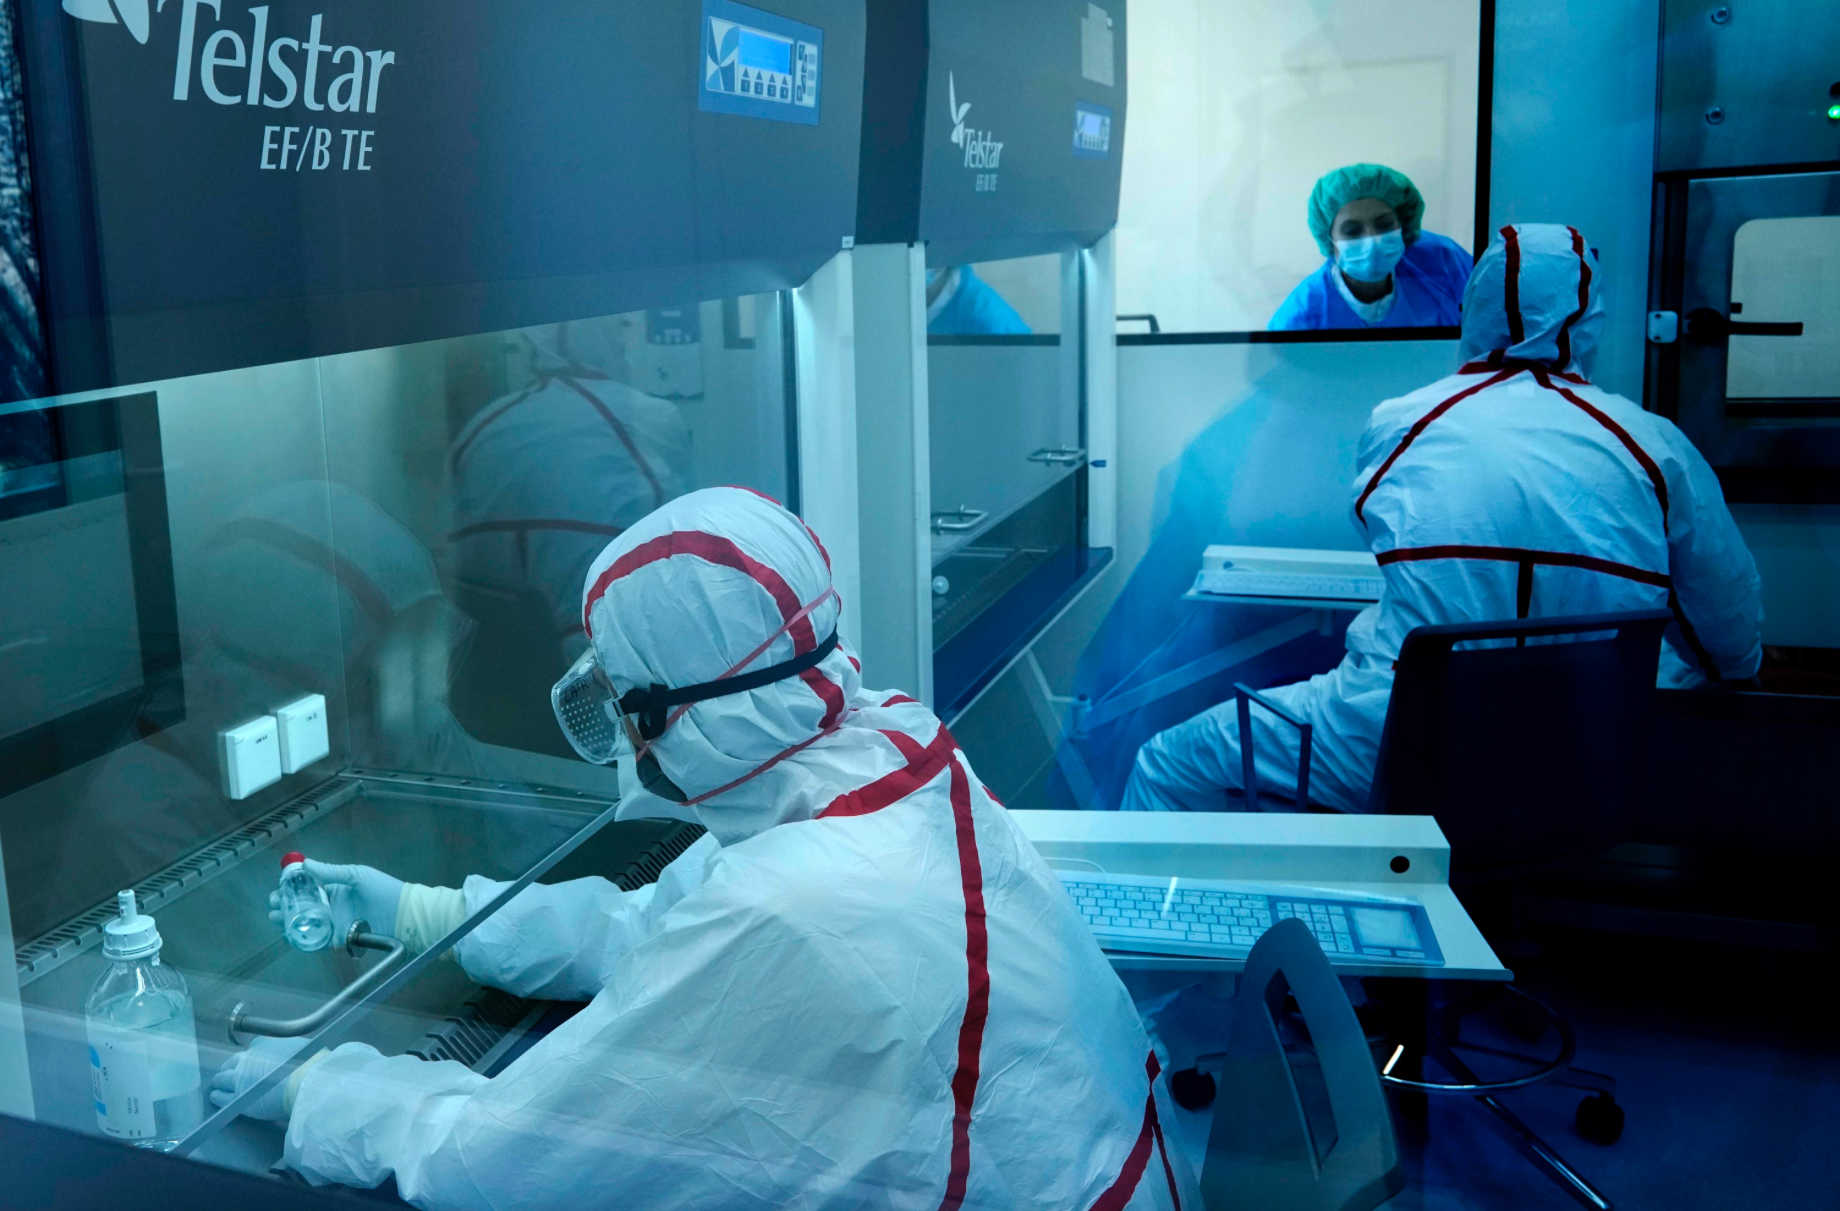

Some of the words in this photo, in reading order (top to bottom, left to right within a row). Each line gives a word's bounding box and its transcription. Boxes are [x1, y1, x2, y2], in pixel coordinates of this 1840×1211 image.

[157, 0, 395, 113] Telstar
[260, 125, 332, 172] EF/B
[341, 129, 375, 171] TE
[964, 128, 1003, 169] Telstar
